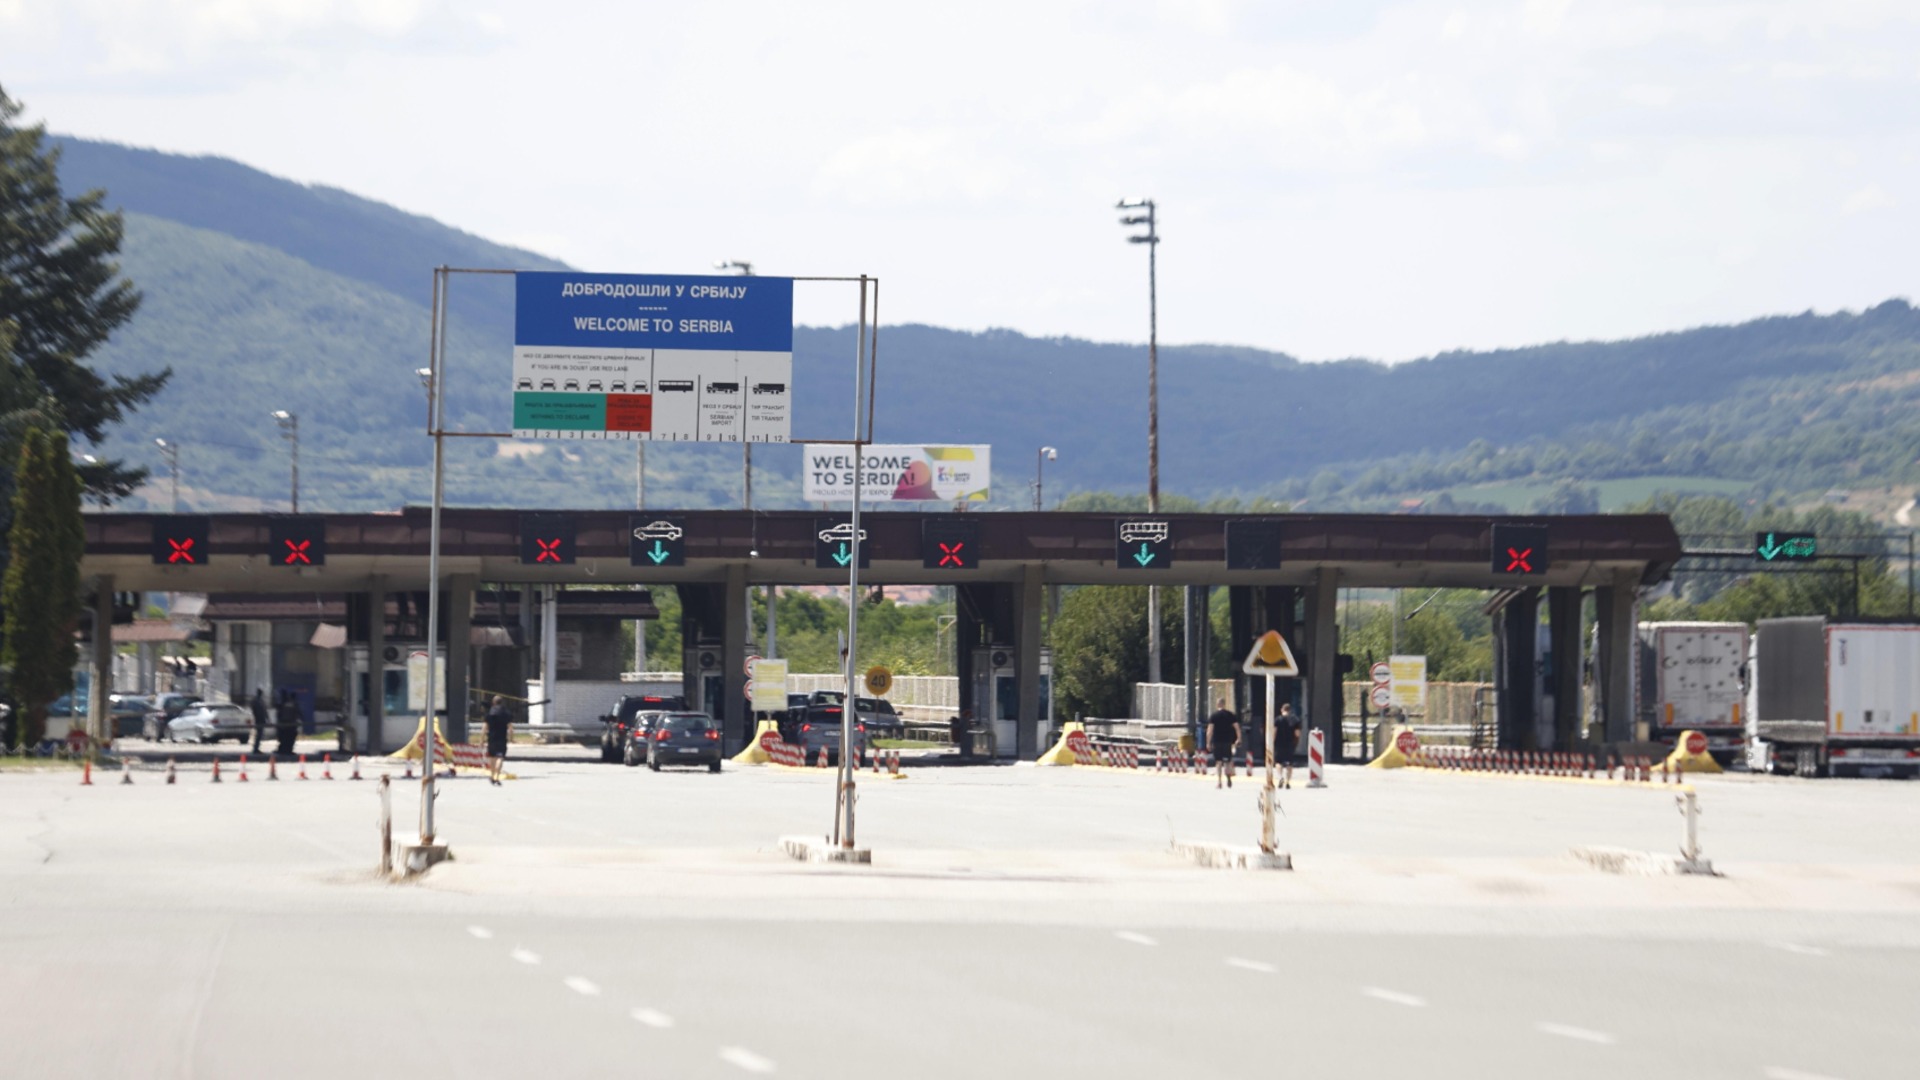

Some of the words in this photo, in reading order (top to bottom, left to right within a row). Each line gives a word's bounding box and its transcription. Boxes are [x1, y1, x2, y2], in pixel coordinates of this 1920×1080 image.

[561, 282, 671, 298] ДОБРОДОШЛИ
[675, 285, 685, 298] У
[690, 285, 747, 299] СРБИЈУ
[574, 317, 649, 332] WELCOME
[652, 318, 673, 333] TO
[679, 319, 734, 334] SERBIA
[812, 472, 837, 486] TO
[870, 674, 886, 688] 40
